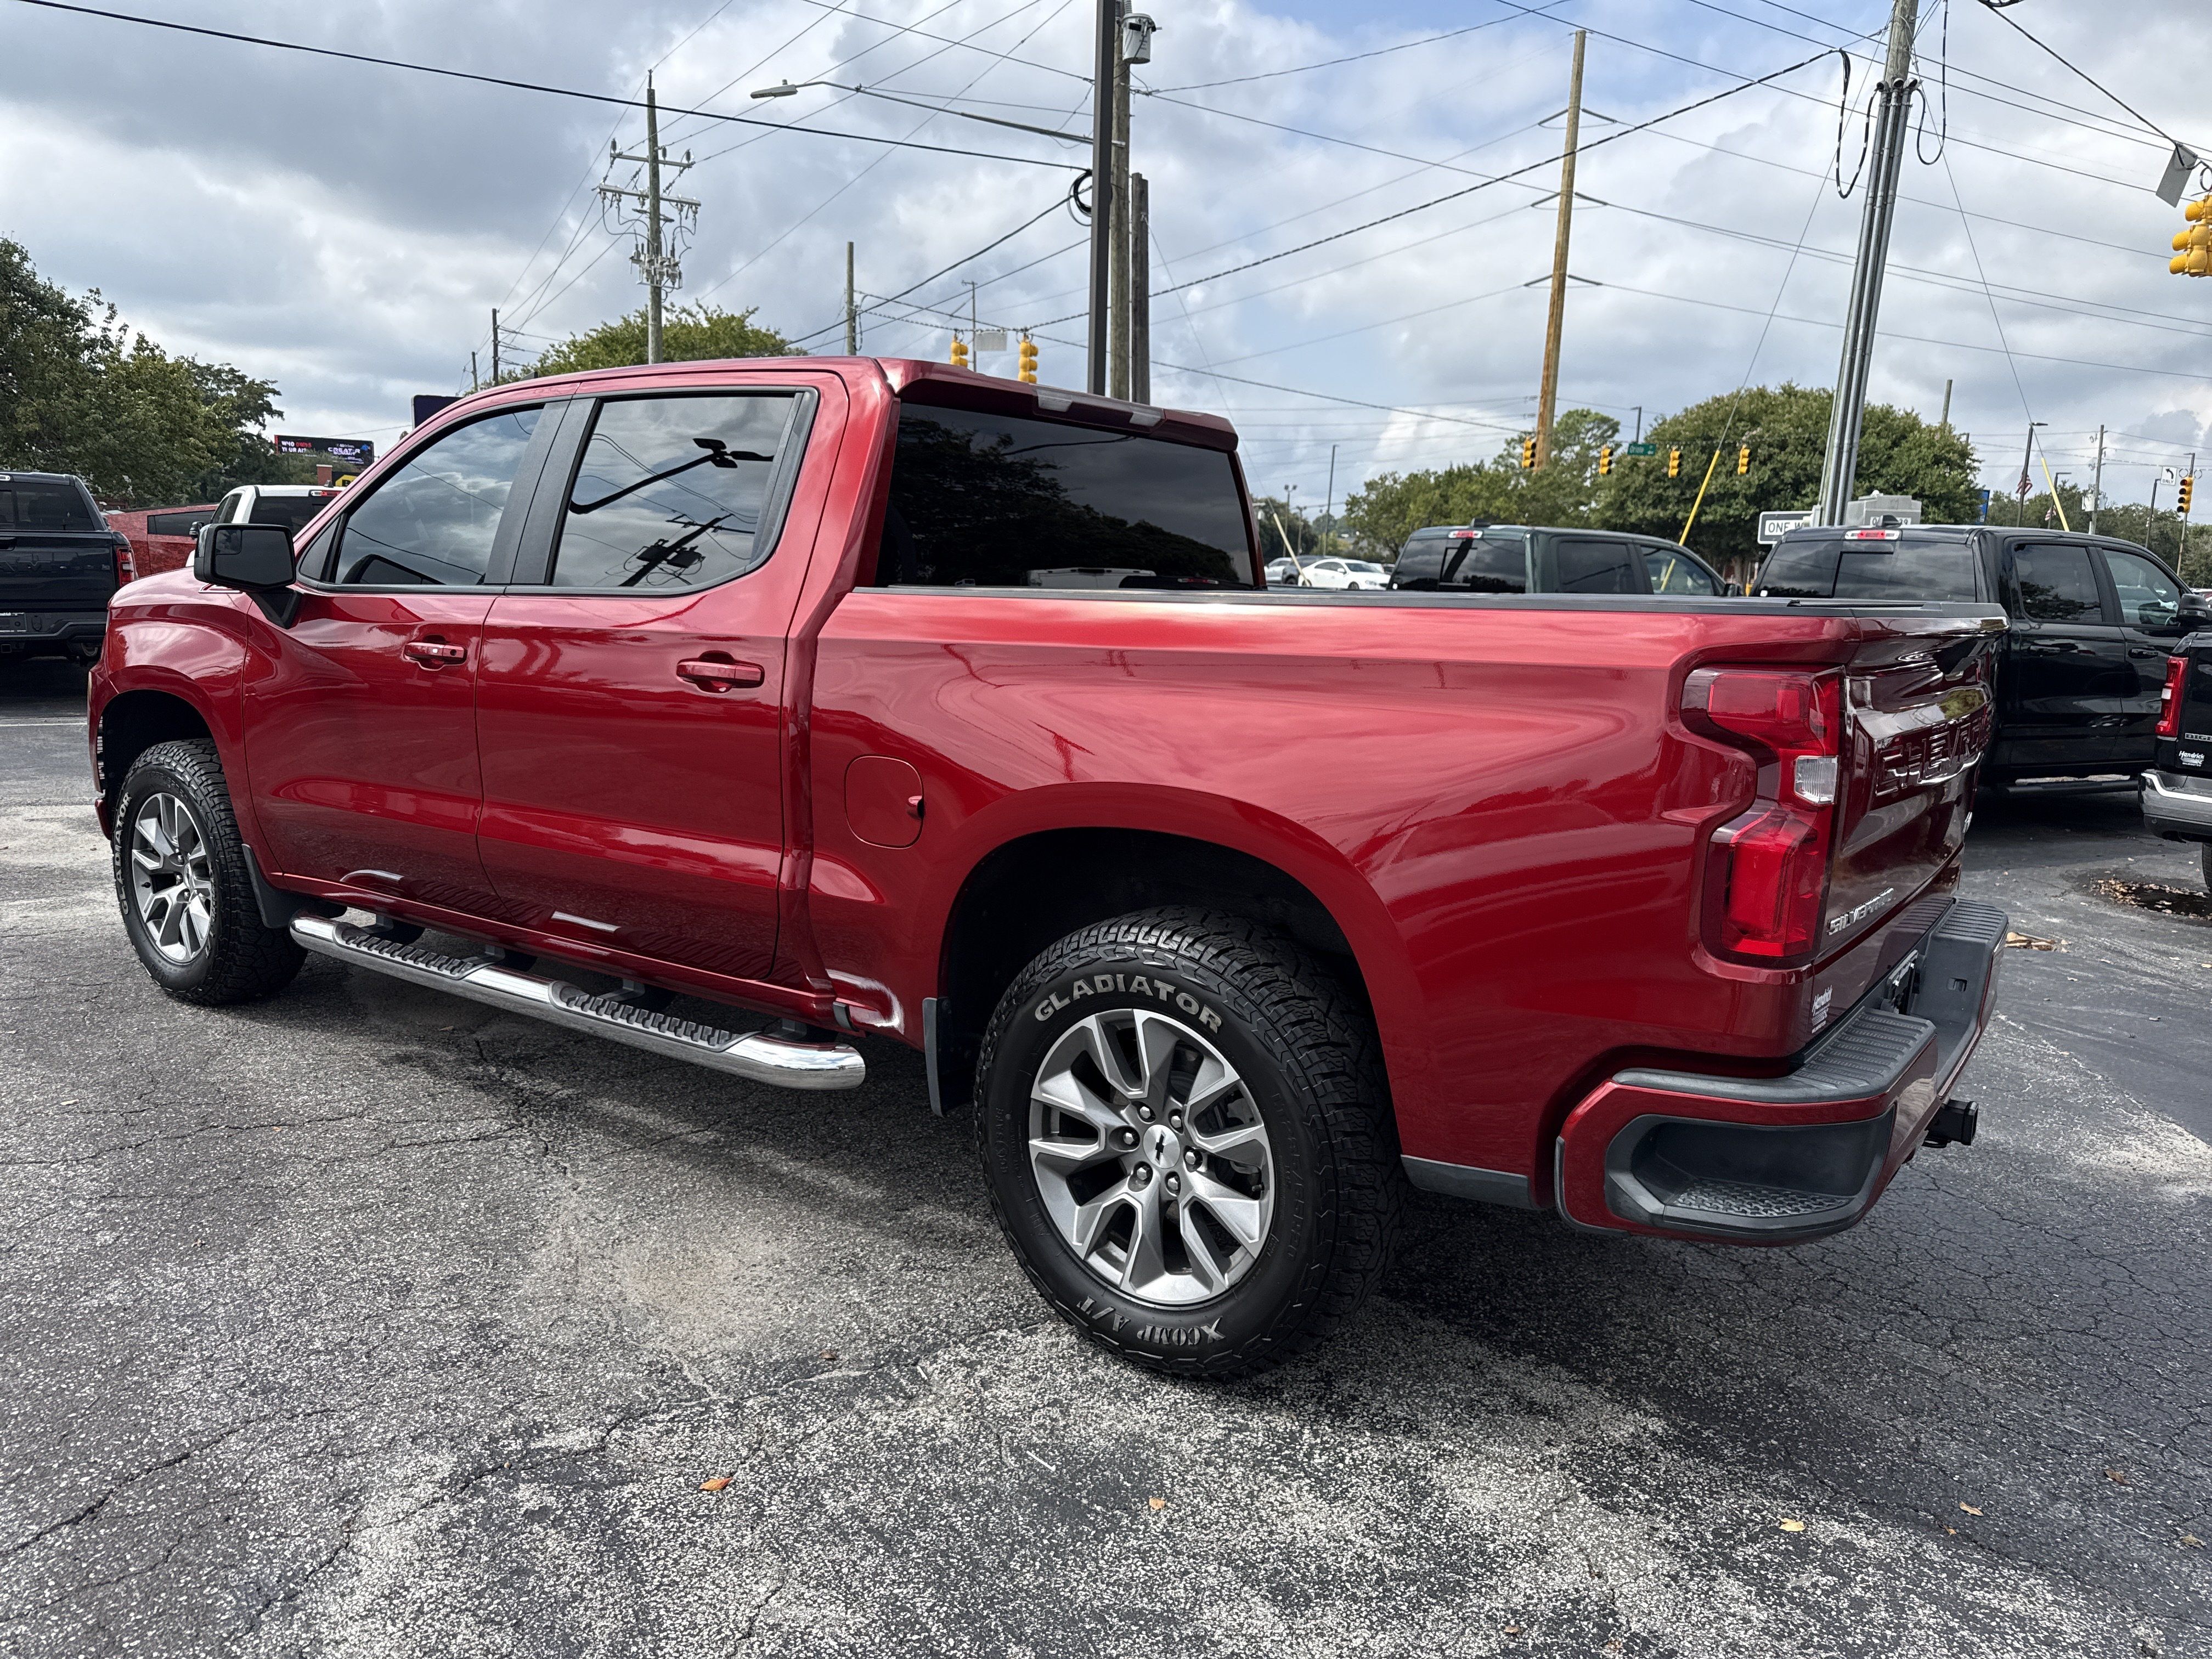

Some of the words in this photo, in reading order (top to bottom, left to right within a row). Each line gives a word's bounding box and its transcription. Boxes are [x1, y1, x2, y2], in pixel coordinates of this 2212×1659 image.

[1768, 522, 1790, 533] ONE
[115, 792, 132, 915] GLADIATOR
[1035, 974, 1222, 1034] GLADIATOR
[1076, 1296, 1131, 1332] A/T
[1137, 1316, 1226, 1346] XCOMP
